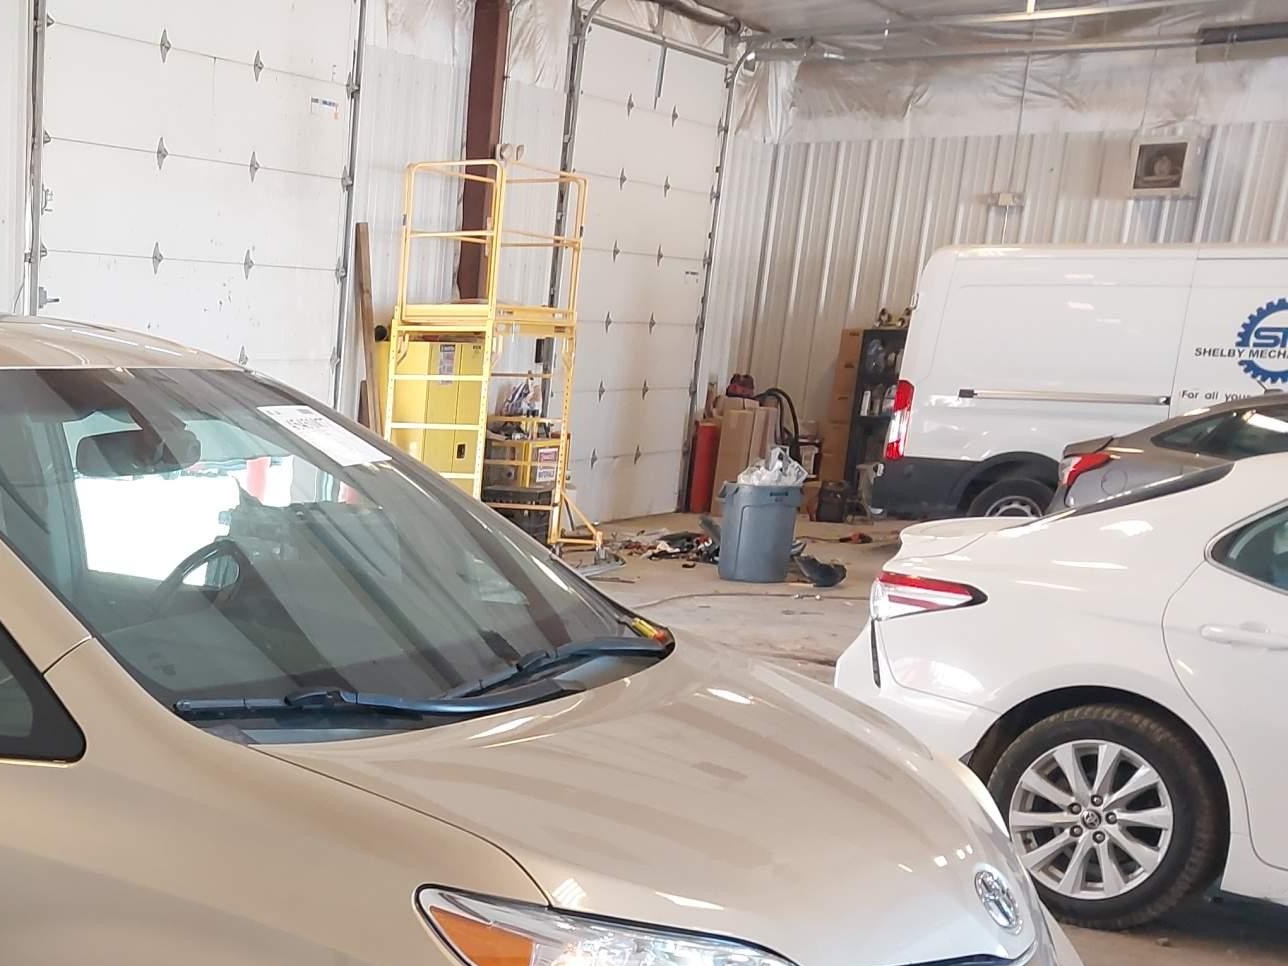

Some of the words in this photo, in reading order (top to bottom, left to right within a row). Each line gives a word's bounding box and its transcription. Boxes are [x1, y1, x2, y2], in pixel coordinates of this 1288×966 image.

[1194, 347, 1245, 358] SHELBY
[1248, 349, 1288, 359] MECH
[1182, 389, 1199, 399] For
[1205, 391, 1219, 400] all
[1224, 392, 1251, 403] you
